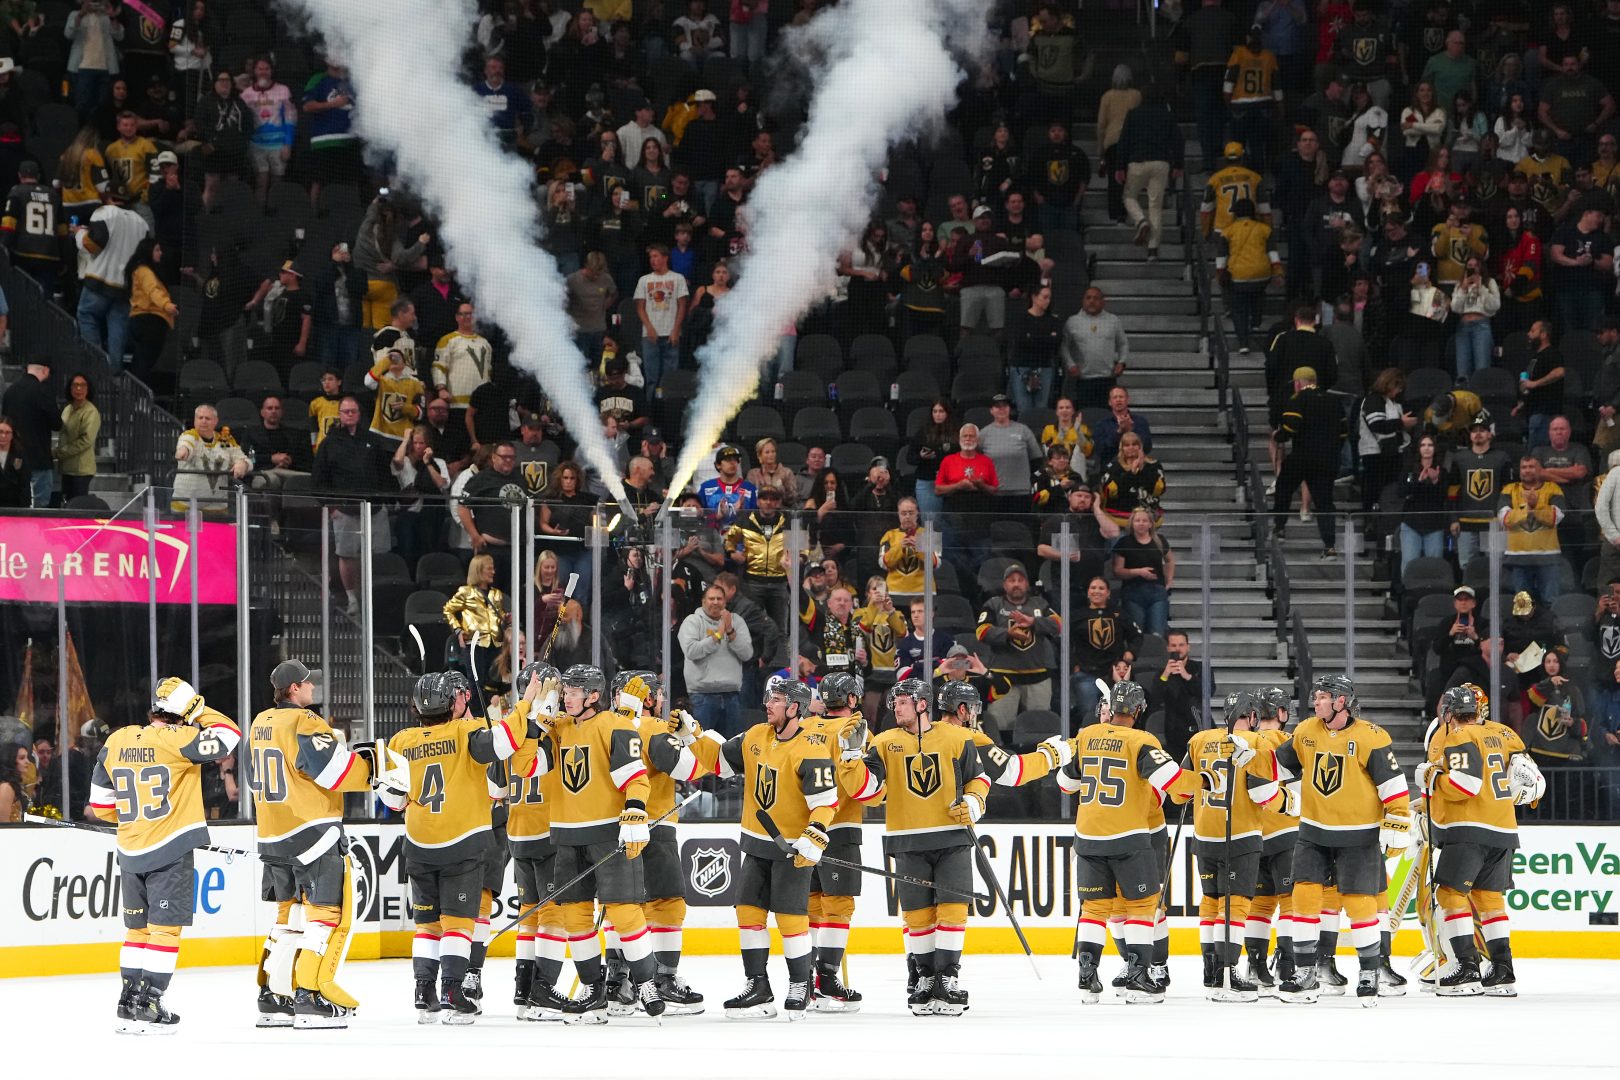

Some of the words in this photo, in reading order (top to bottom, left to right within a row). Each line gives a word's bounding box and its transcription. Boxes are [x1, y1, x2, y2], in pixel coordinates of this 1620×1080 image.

[26, 201, 54, 236] 61
[40, 552, 162, 580] ARENA
[311, 733, 334, 751] 40
[402, 739, 457, 762] ANDERSSON
[628, 738, 641, 758] 6
[1086, 738, 1123, 752] KOLESAR
[1203, 741, 1220, 753] SISS
[1347, 740, 1356, 757] A
[118, 747, 156, 763] MARNER
[1386, 751, 1400, 770] 3
[1449, 752, 1469, 769] 21
[418, 763, 445, 813] 4
[813, 767, 834, 787] 19
[1080, 755, 1128, 807] 55
[1486, 752, 1513, 801] 2
[111, 764, 172, 823] 93
[1383, 822, 1408, 830] CCM
[700, 860, 723, 887] NHL
[1511, 852, 1573, 875] een
[22, 851, 121, 921] Credi
[1006, 835, 1075, 917] AUT
[1505, 888, 1613, 912] ocery
